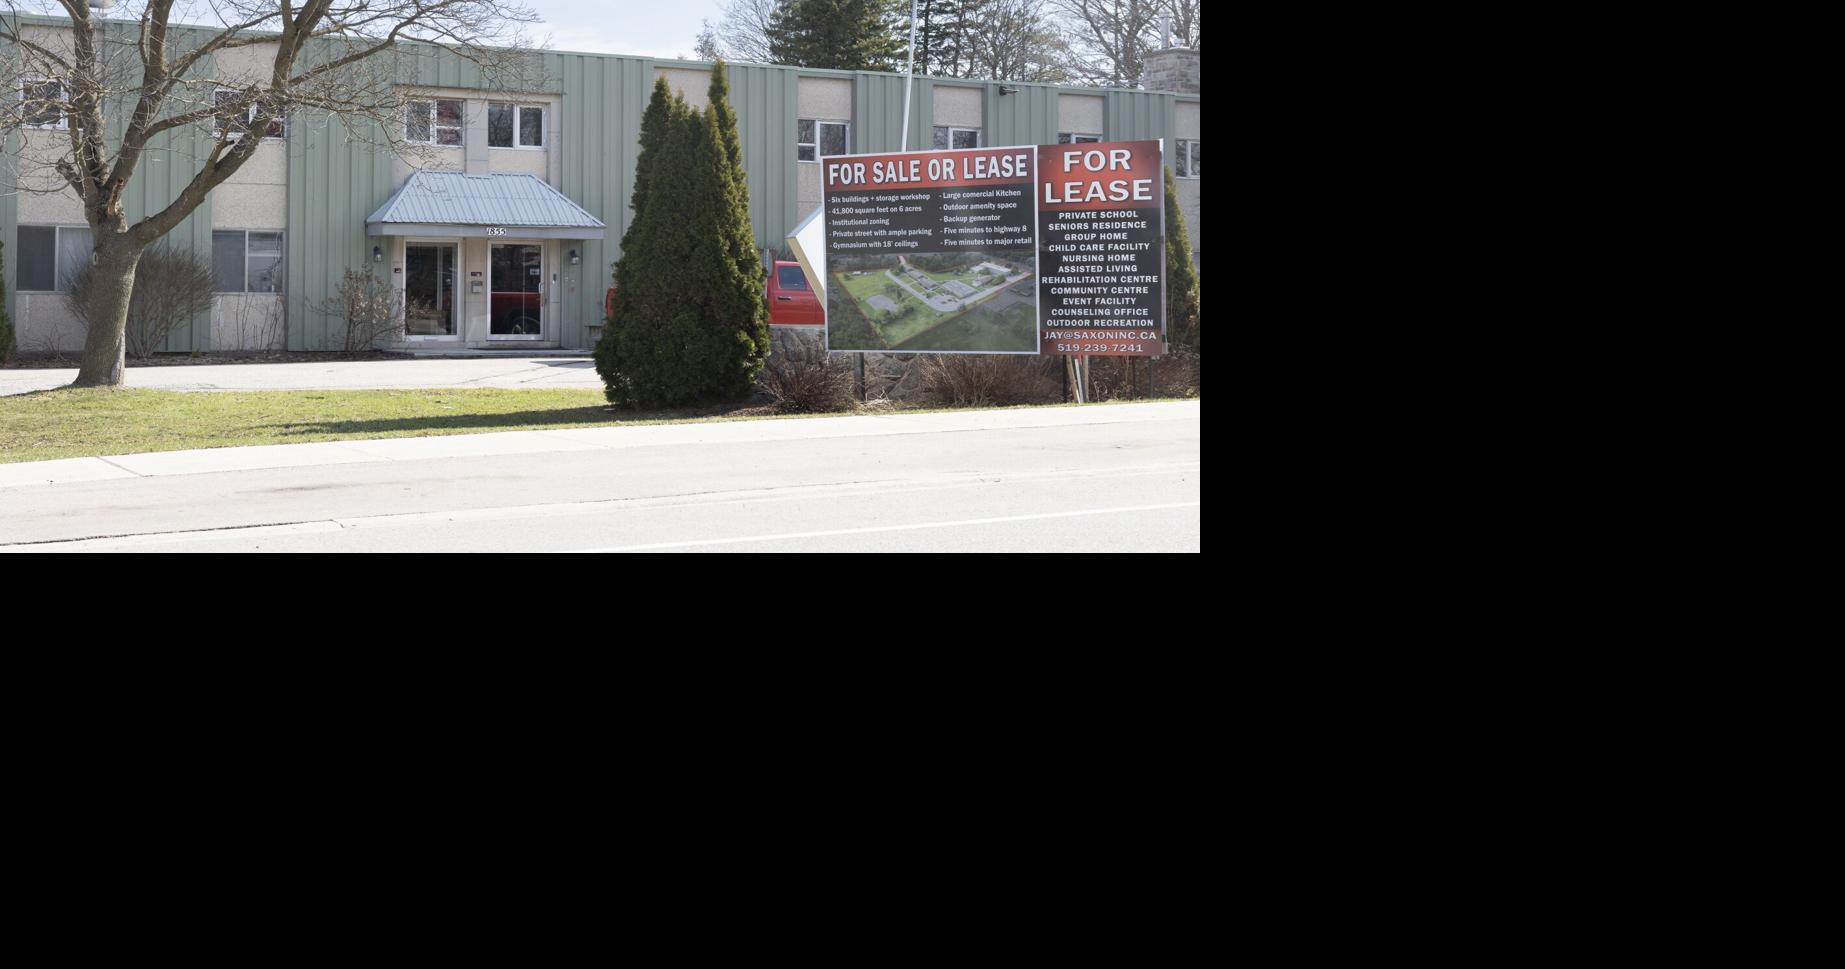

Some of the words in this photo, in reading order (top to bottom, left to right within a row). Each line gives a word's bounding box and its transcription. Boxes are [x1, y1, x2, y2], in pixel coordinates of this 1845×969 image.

[1064, 149, 1131, 172] FOR
[829, 163, 866, 185] FOR
[872, 159, 920, 184] SALE
[928, 158, 954, 180] OR
[963, 154, 1028, 179] LEASE
[962, 190, 994, 198] comercial
[1045, 179, 1152, 203] LEASE
[841, 196, 869, 204] buildings
[970, 202, 996, 210] amenity
[968, 214, 1000, 222] generator
[1048, 222, 1089, 230] SENIORS
[1092, 221, 1147, 229] RESIDENCE
[486, 227, 506, 236] 1855
[908, 228, 932, 236] parking
[994, 226, 1020, 234] highway
[832, 242, 868, 250] Gymnasium
[1108, 242, 1150, 250] FACILITY
[1042, 276, 1117, 284] REHABILITATION
[1044, 332, 1156, 340] JAY@SAXONINC.CA
